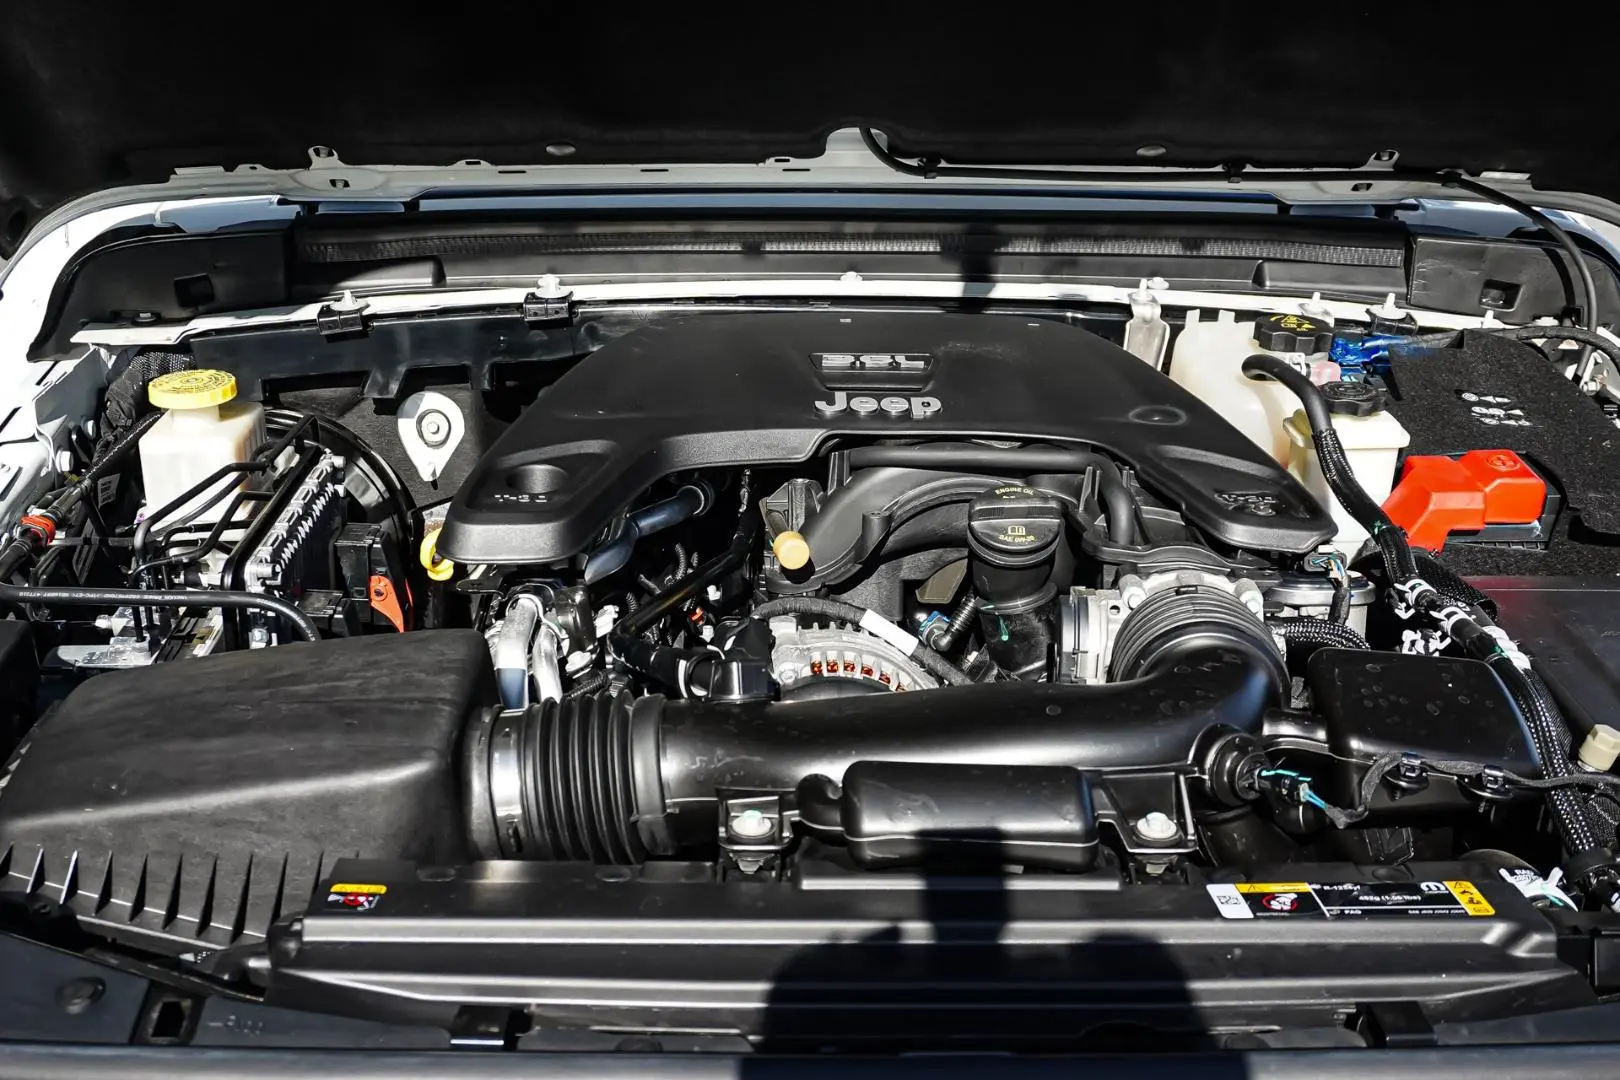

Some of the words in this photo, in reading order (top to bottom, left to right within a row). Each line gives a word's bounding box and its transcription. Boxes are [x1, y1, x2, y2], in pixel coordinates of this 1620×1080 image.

[813, 391, 942, 418] Jeep
[994, 487, 1022, 495] ENGINE
[1023, 488, 1034, 496] OIL
